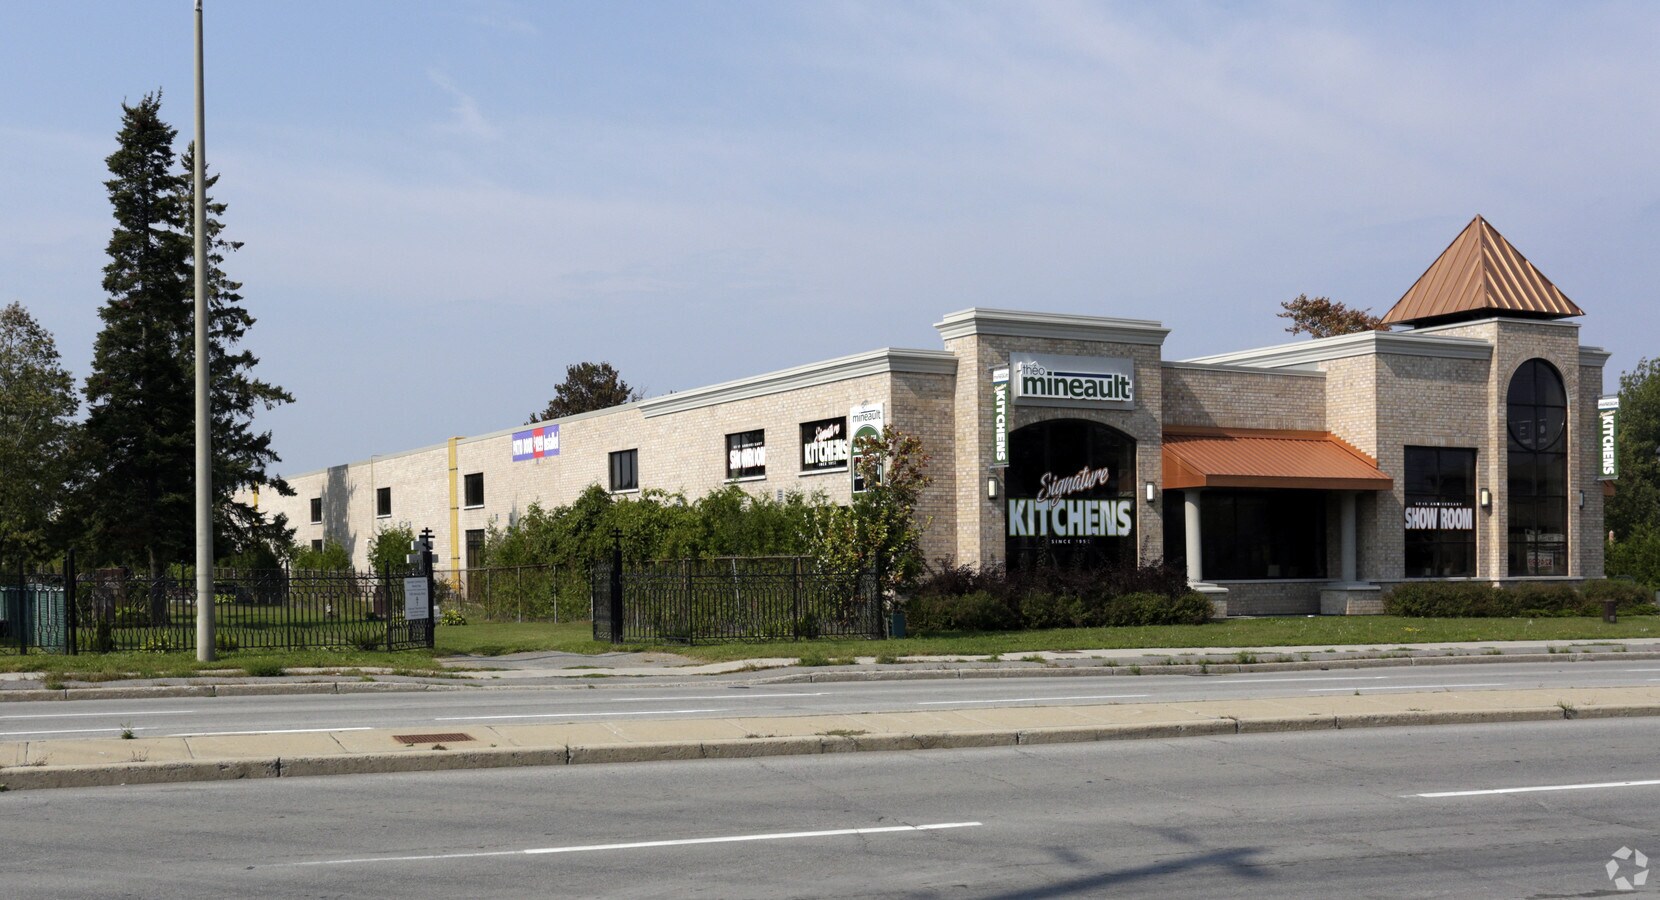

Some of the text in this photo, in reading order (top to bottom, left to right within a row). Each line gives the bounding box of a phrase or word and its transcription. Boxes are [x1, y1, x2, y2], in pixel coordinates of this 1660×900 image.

[1022, 371, 1130, 399] mineault
[1023, 365, 1045, 376] théo
[996, 389, 1006, 461] KITCHENS
[1602, 415, 1615, 475] KITCHENS
[1036, 466, 1109, 507] Signature
[1008, 499, 1132, 537] KITCHENS
[1404, 507, 1473, 530] SHOW ROOM
